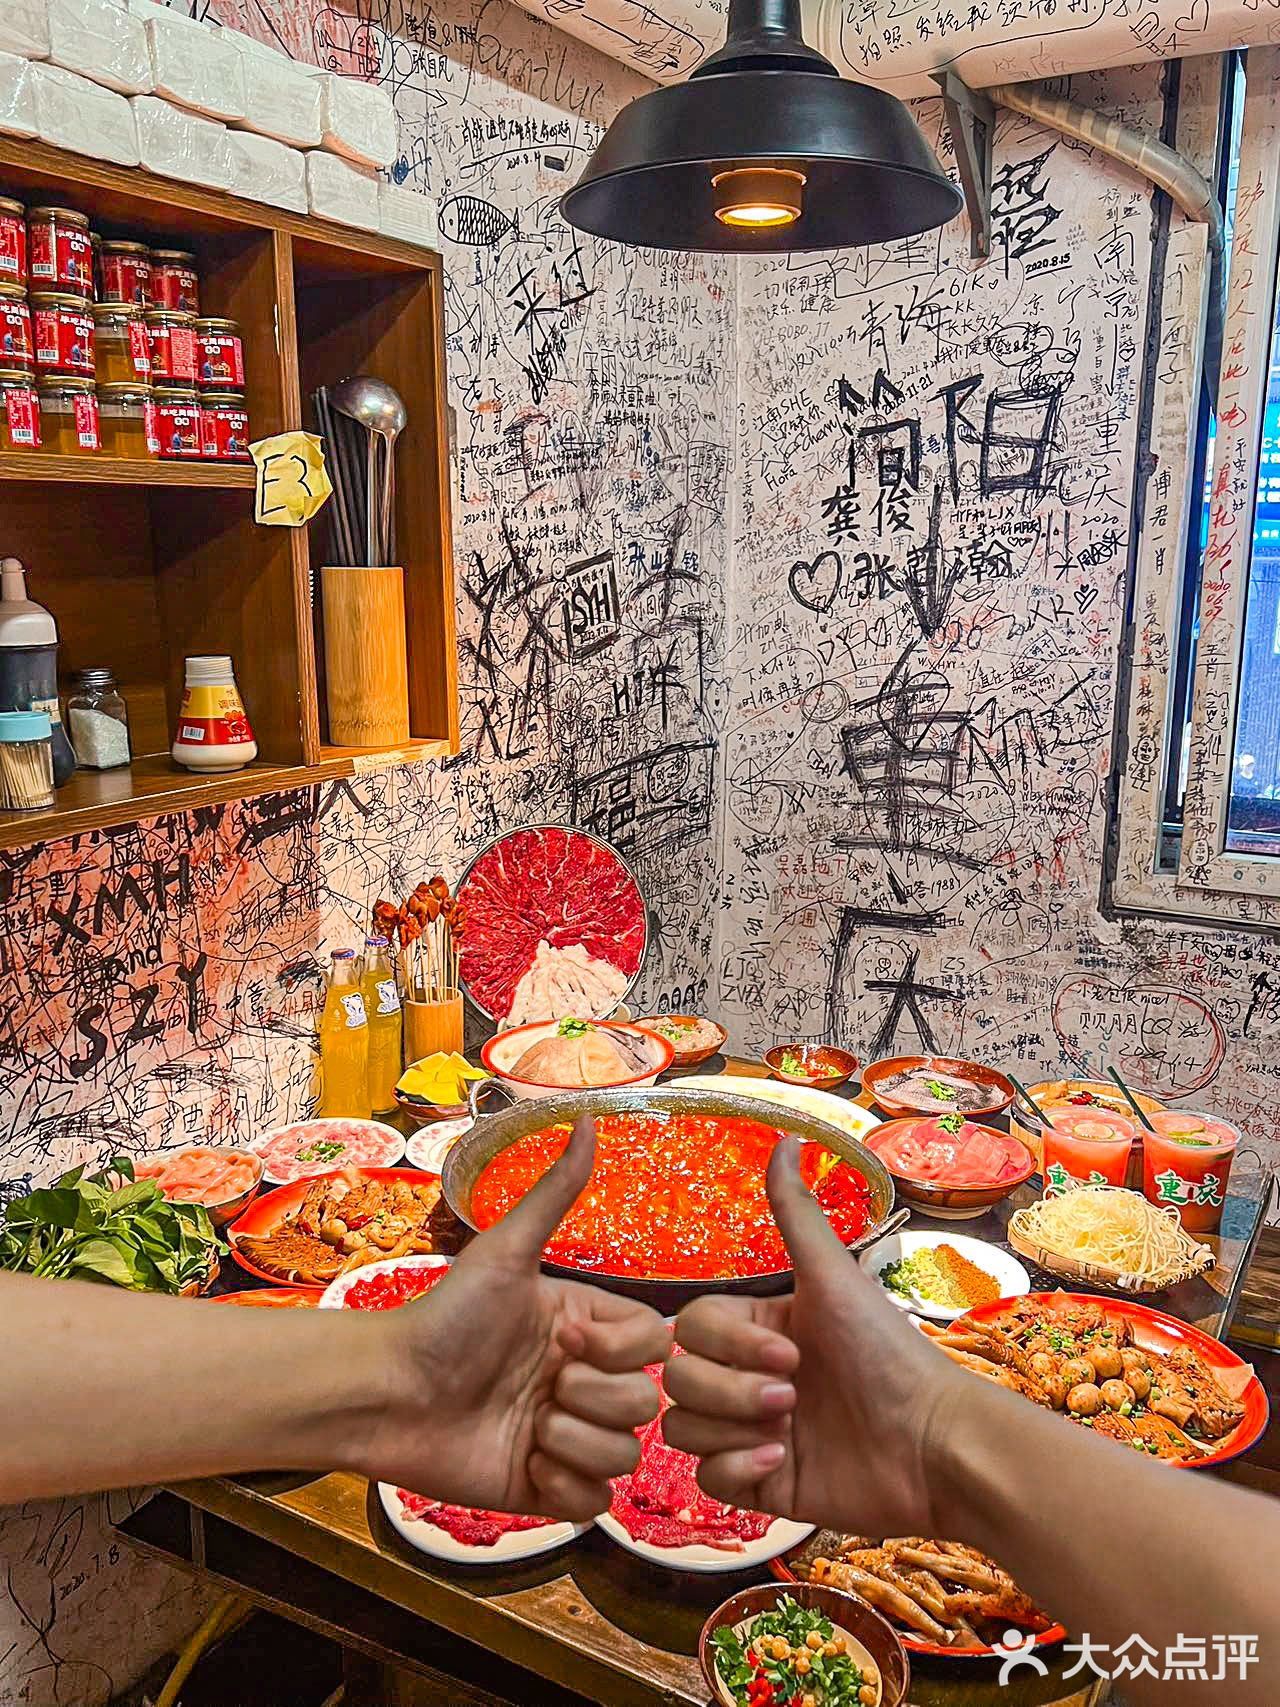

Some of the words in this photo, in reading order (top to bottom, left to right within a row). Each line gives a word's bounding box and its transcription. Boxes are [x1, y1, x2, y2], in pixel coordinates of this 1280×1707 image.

[820, 486, 915, 548] 龚俊
[49, 853, 191, 957] XMH
[70, 952, 207, 1078] SZY
[1154, 1168, 1222, 1206] 重庆
